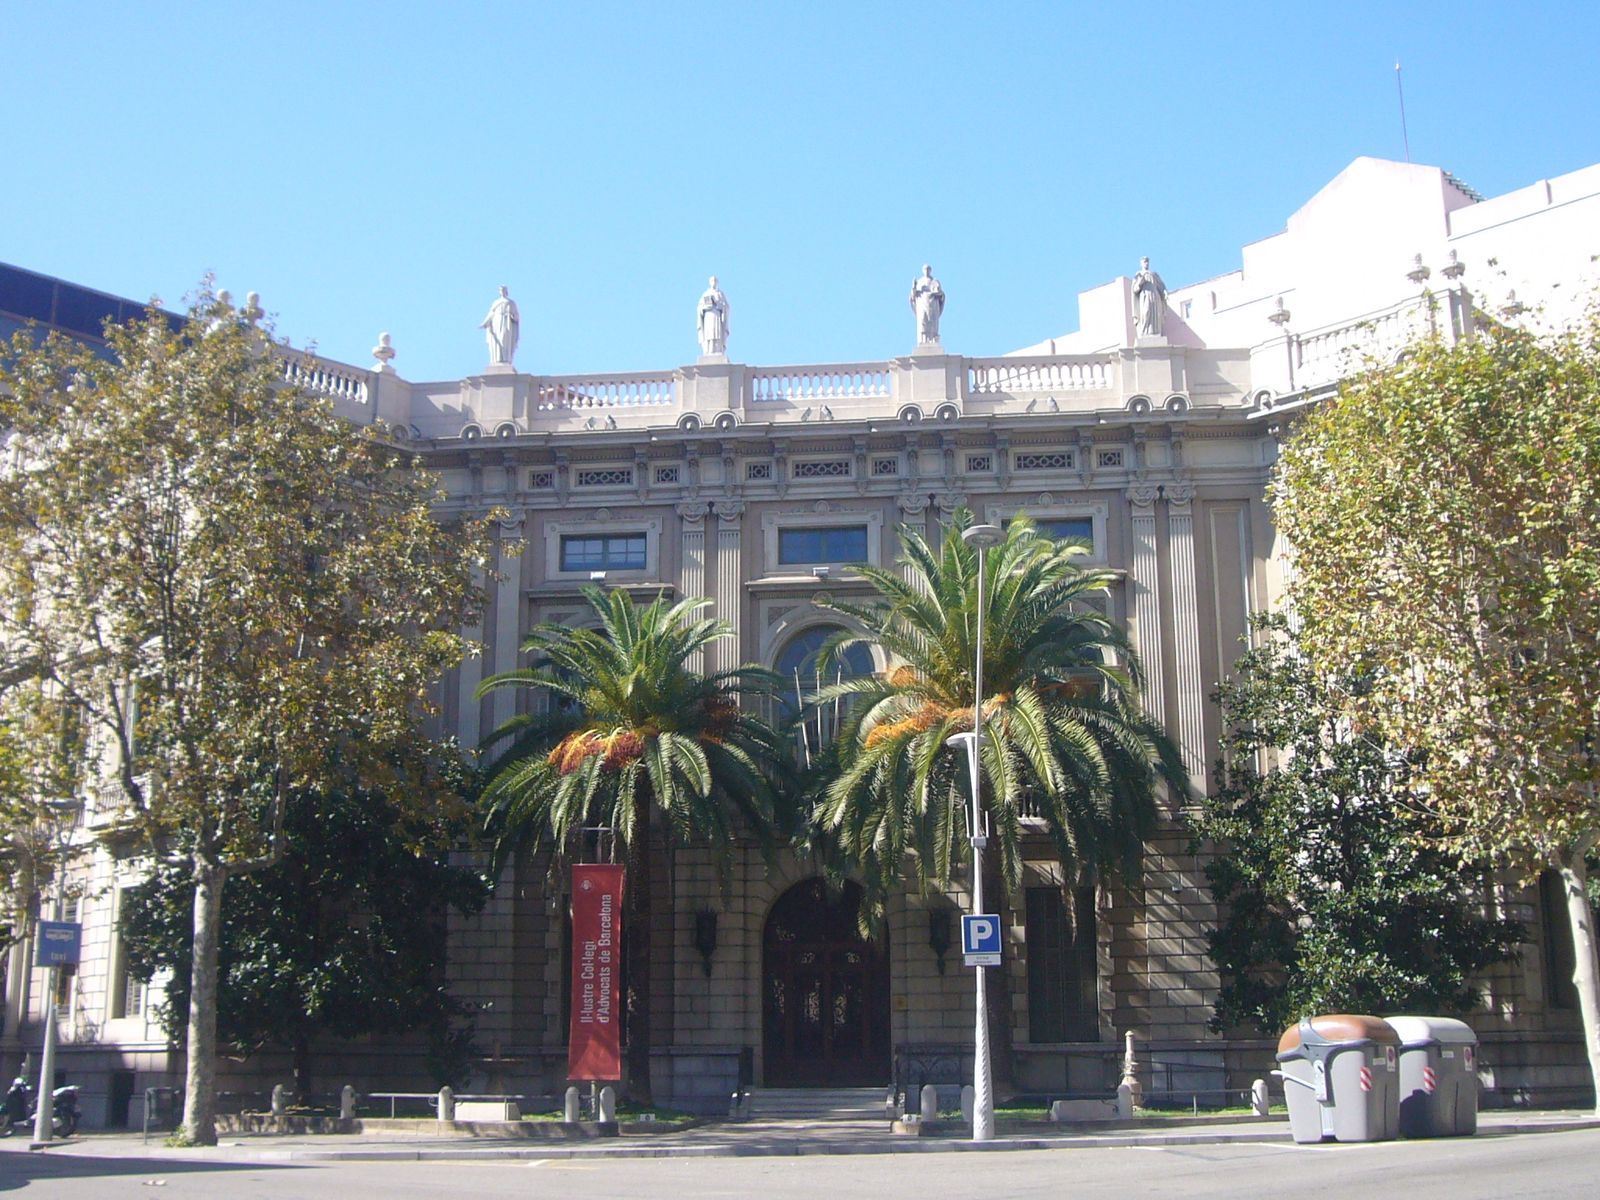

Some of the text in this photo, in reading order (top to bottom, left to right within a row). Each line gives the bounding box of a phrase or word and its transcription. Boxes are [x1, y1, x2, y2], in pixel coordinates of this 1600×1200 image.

[597, 894, 612, 1023] d'Advocats de Barcelona
[970, 919, 993, 950] P
